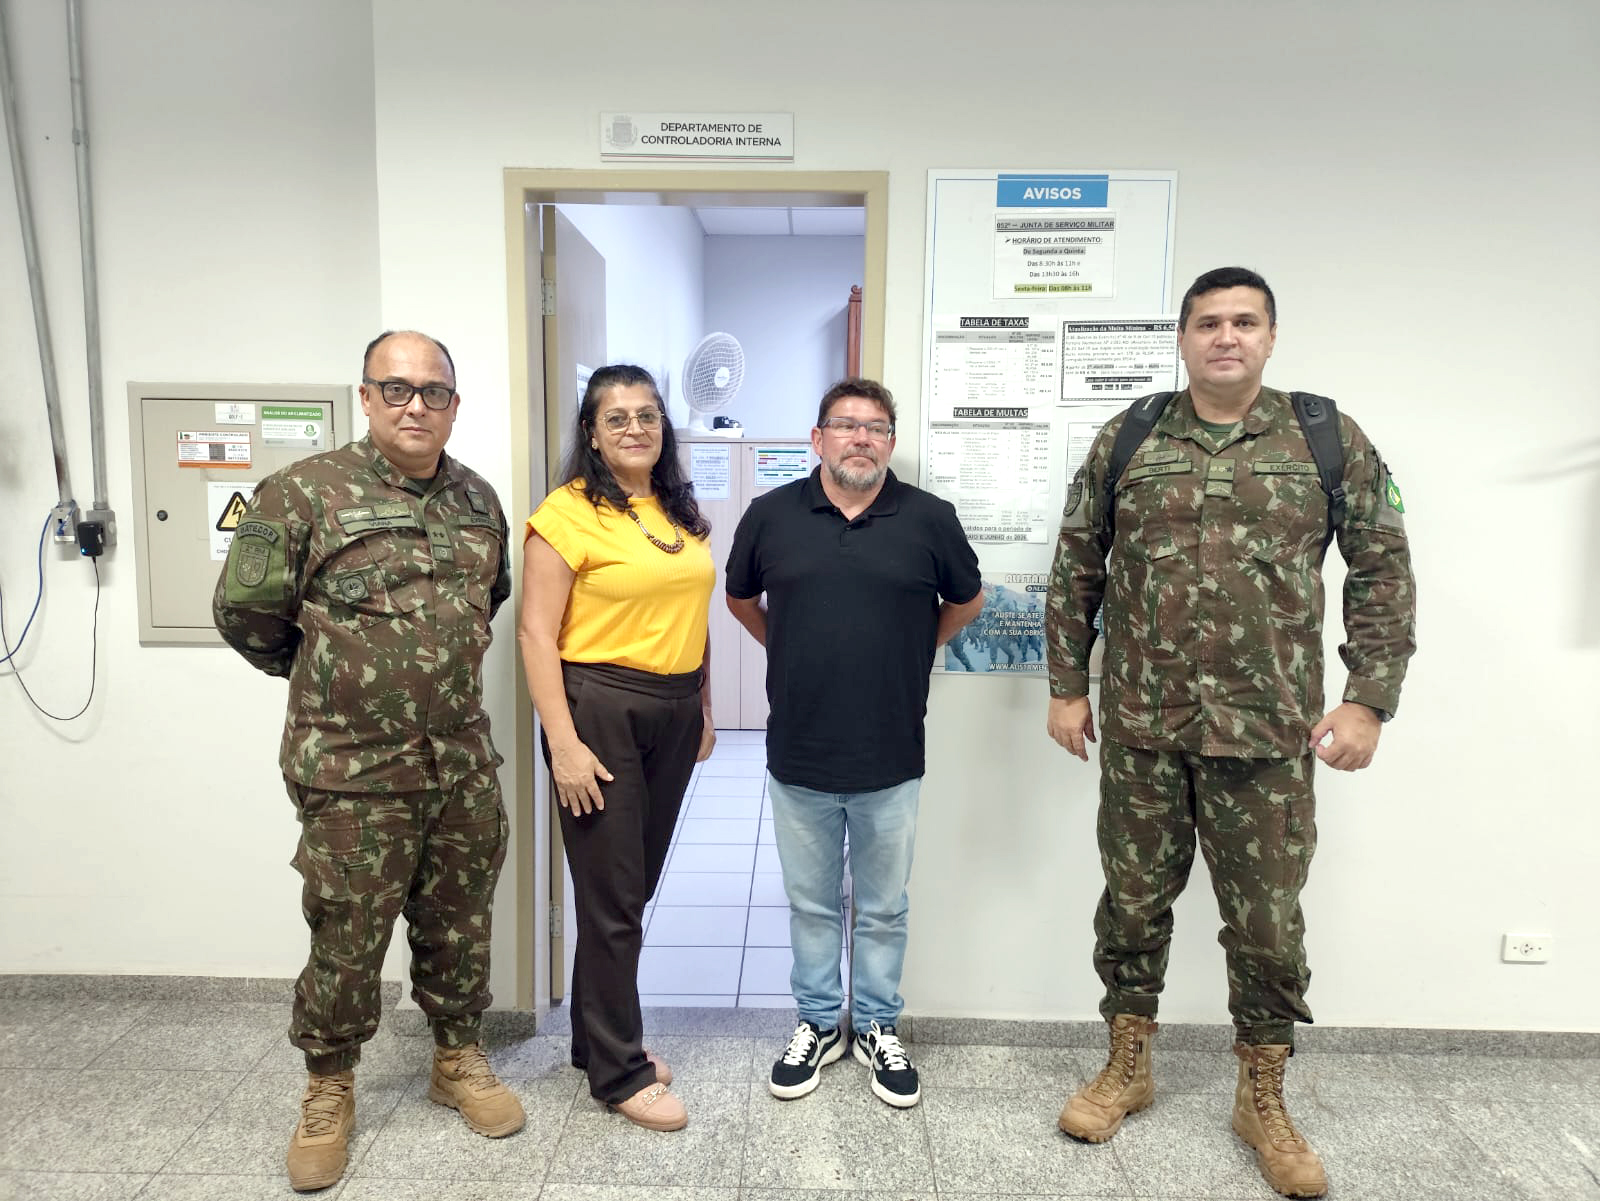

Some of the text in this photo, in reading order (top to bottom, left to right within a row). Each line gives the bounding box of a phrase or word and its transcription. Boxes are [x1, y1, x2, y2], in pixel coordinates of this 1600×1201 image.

[660, 122, 762, 133] DEPARTAMENTO DE
[641, 135, 781, 146] CONTROLADORIA INTERNA
[1023, 187, 1082, 200] AVISOS
[1020, 221, 1042, 229] JUNTA
[1055, 221, 1086, 229] SERVIÇO
[1012, 236, 1042, 244] HORÁRIO
[1032, 248, 1058, 256] Segunda
[960, 318, 1029, 327] TABELA DE TAXAS
[953, 408, 1028, 417] TABELA DE MULTAS
